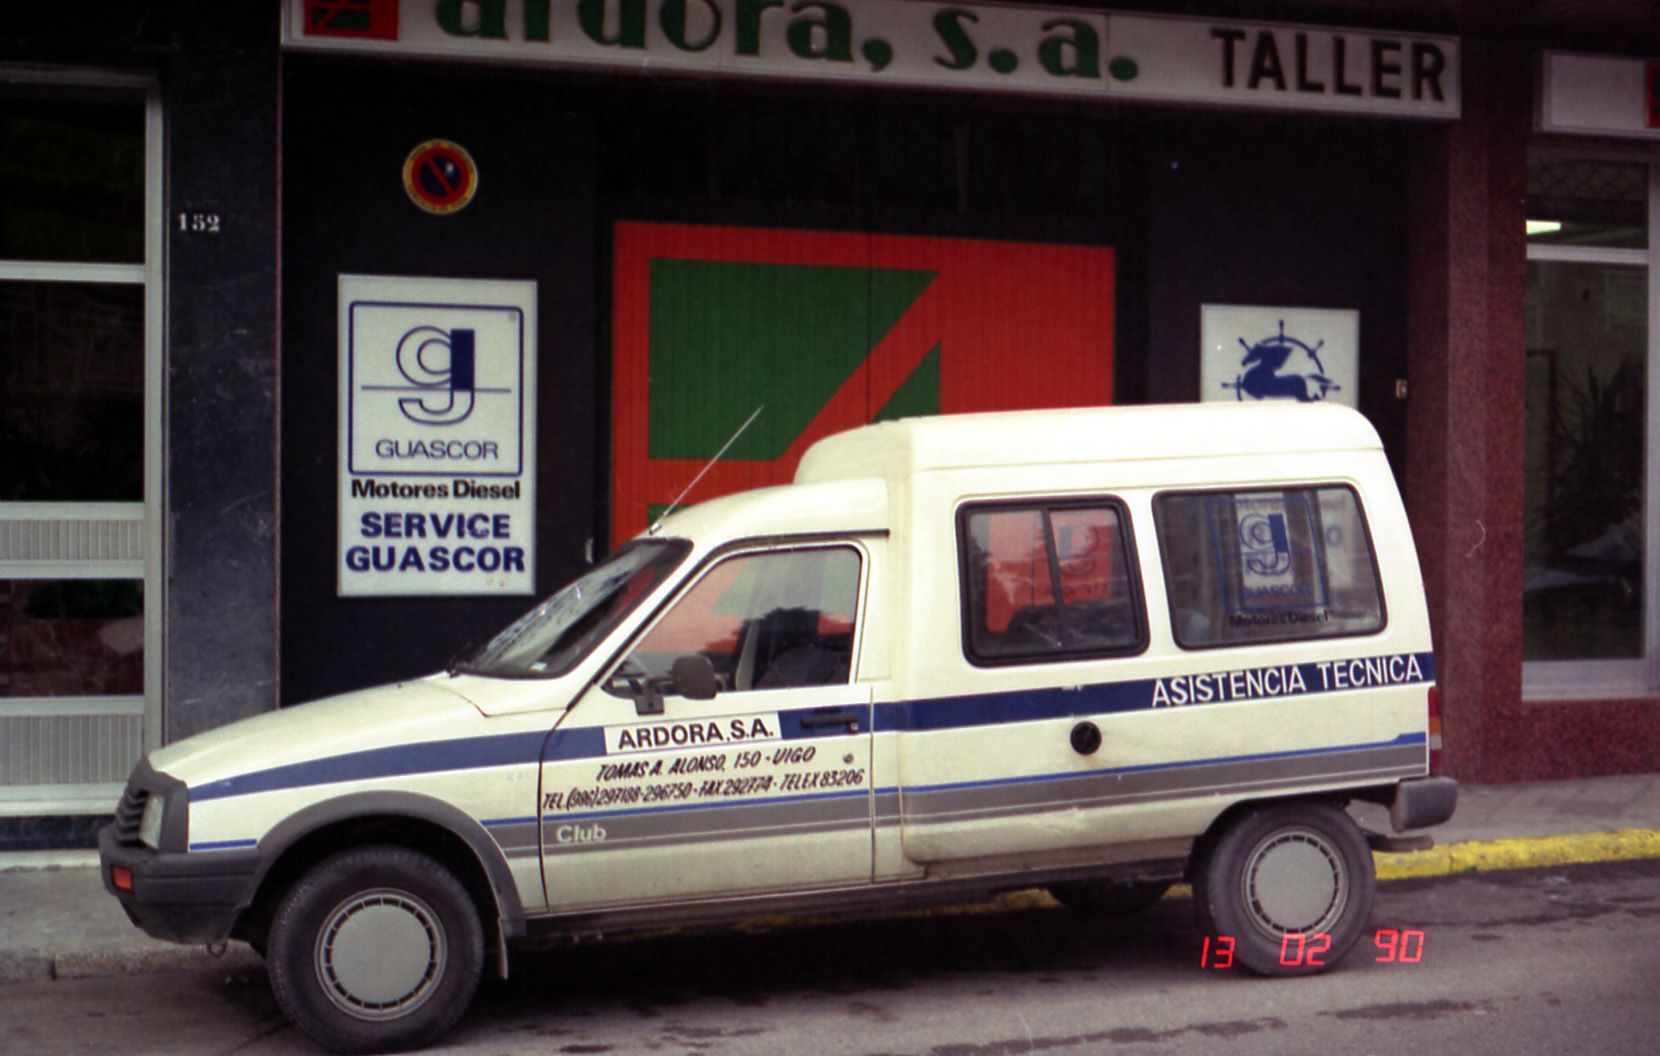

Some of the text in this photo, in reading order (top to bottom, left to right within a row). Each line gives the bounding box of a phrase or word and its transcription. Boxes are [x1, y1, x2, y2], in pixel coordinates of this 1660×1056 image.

[1211, 27, 1447, 102] TALLER
[179, 213, 220, 232] 152
[375, 438, 499, 460] GUASCOR
[351, 478, 521, 500] Motores Diesel
[360, 511, 511, 539] SERVICE
[345, 545, 525, 573] GUASCOR
[1151, 654, 1423, 708] ASISTENCIA TECNICA
[596, 760, 649, 782] TOMAS
[733, 750, 762, 769] 150
[556, 824, 607, 844] Club
